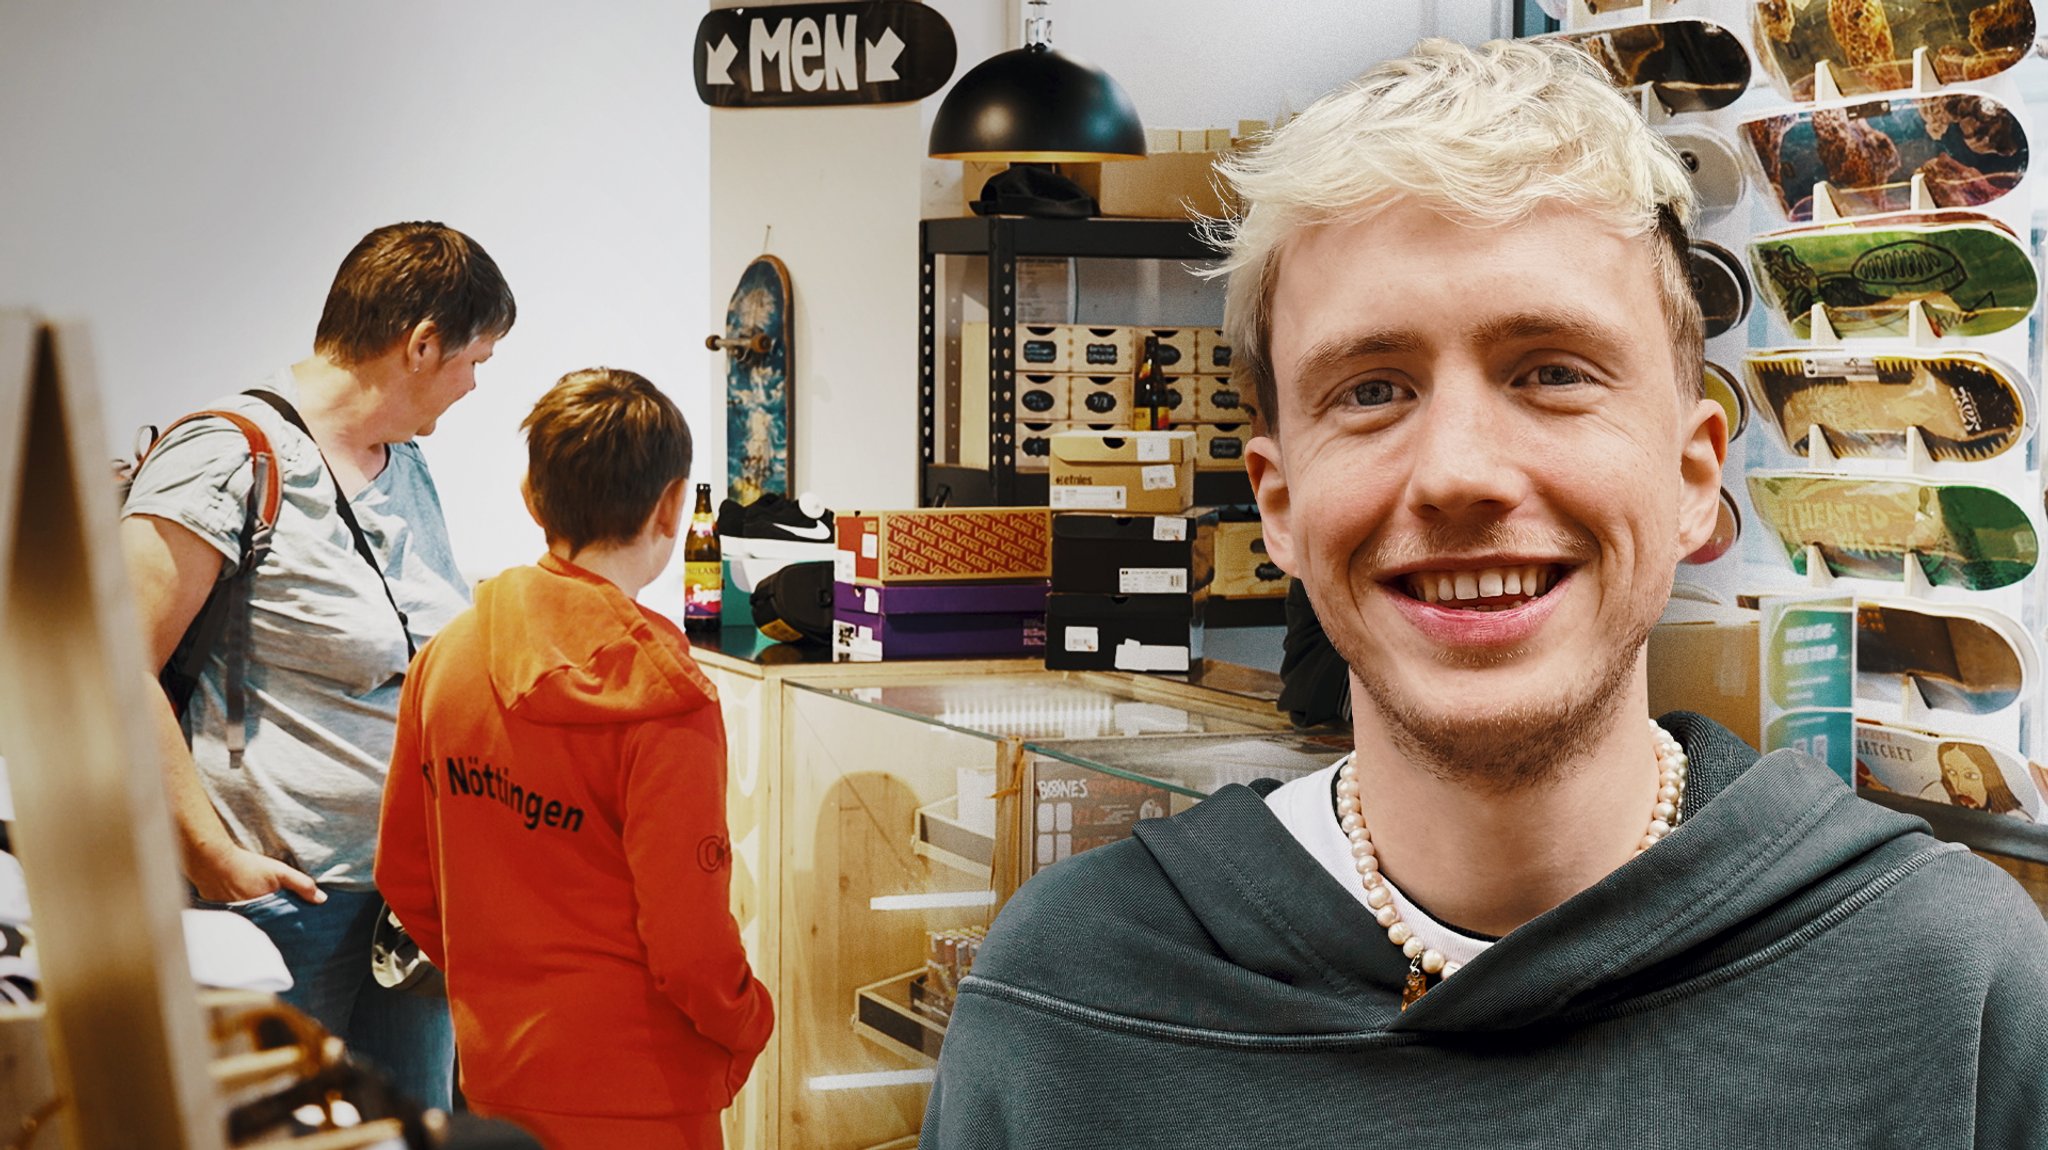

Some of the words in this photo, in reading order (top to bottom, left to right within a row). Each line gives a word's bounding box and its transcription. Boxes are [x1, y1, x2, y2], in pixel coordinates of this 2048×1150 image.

[1063, 474, 1093, 486] etnies
[930, 519, 955, 539] VANS
[948, 515, 974, 533] VANS
[992, 521, 1017, 541] VANS
[1010, 516, 1034, 535] VANS
[894, 531, 920, 550] VANS
[912, 525, 937, 545] VANS
[957, 532, 981, 552] VANS
[975, 526, 999, 546] VANS
[1018, 534, 1042, 553] VANS
[921, 544, 946, 563] VANS
[939, 538, 964, 558] VANS
[983, 545, 1008, 565] VANS
[1001, 540, 1025, 559] VANS
[888, 557, 910, 574] ANS
[903, 549, 929, 569] VANS
[966, 551, 990, 570] VANS
[446, 756, 585, 832] Nöttingen
[1036, 778, 1089, 800] BONES
